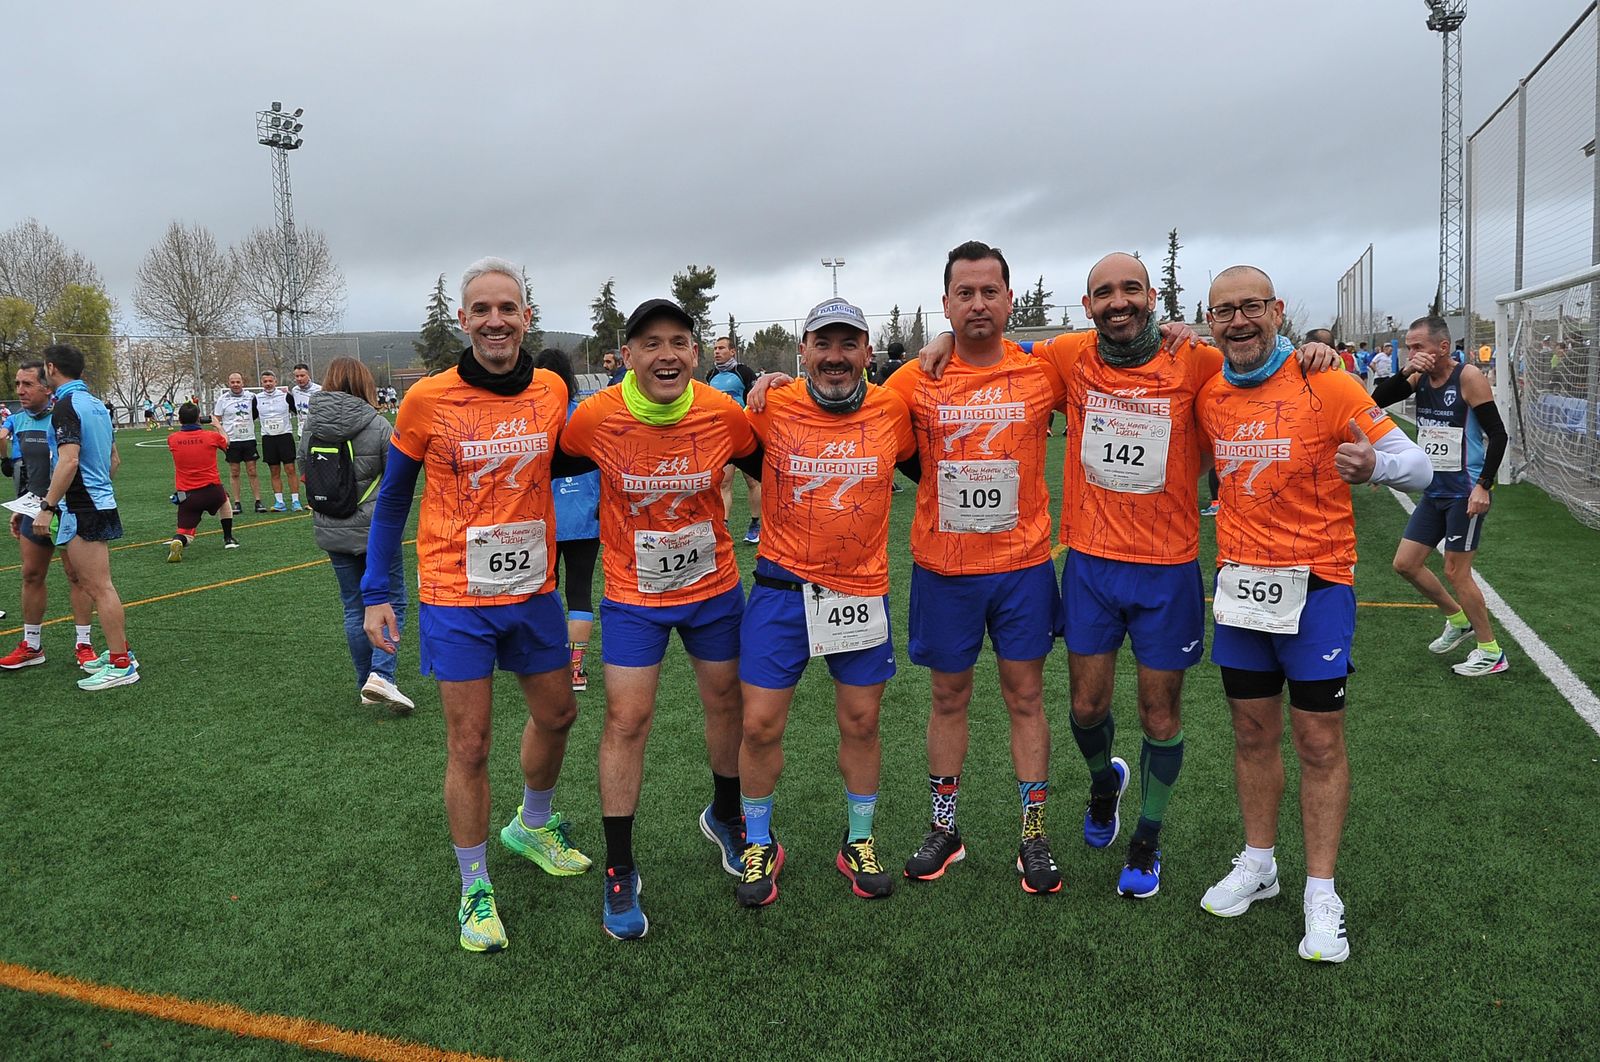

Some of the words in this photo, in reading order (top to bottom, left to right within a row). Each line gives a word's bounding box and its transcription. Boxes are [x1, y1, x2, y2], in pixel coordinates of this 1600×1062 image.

[1102, 442, 1145, 467] 142
[1424, 442, 1449, 456] 629
[958, 488, 1002, 509] 109
[489, 550, 531, 573] 652
[658, 548, 699, 573] 124
[1236, 578, 1283, 605] 569
[827, 603, 869, 627] 498
